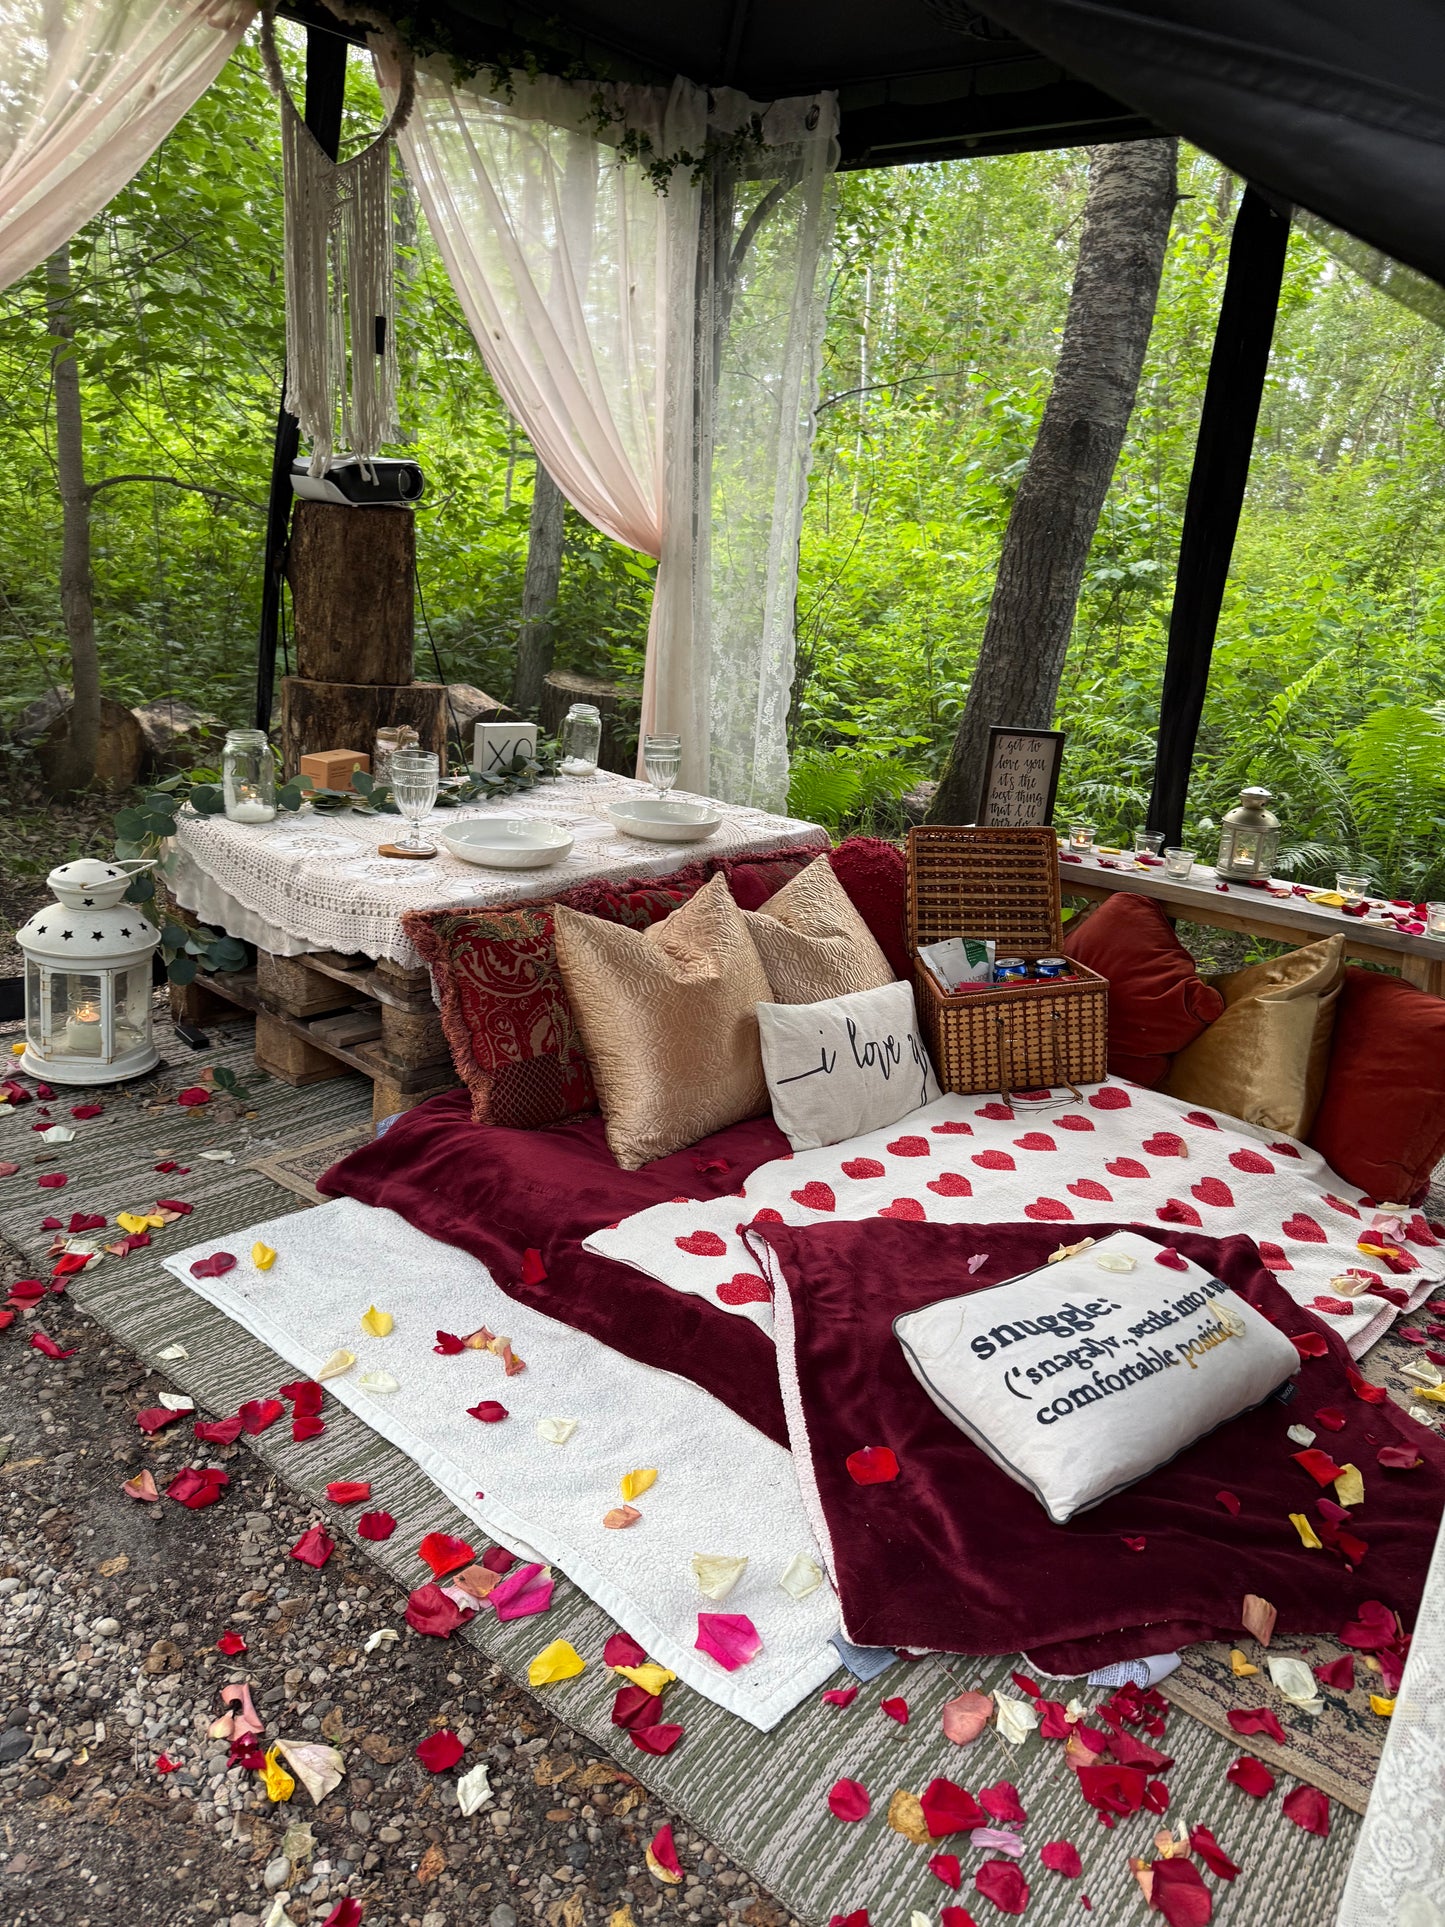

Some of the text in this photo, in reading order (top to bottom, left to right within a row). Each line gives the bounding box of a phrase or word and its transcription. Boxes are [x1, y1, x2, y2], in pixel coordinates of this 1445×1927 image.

[1006, 738, 1025, 754] get
[1028, 739, 1043, 752] to
[995, 754, 1046, 774] love you
[1018, 774, 1037, 790] the
[992, 787, 1045, 807] best thing
[990, 803, 1014, 816] that
[846, 1017, 900, 1080] love
[1128, 1310, 1180, 1338] settle
[1163, 1291, 1207, 1317] into
[1200, 1286, 1216, 1298] a
[971, 1298, 1122, 1360] snuggle:
[1036, 1319, 1233, 1425] comfortable positio
